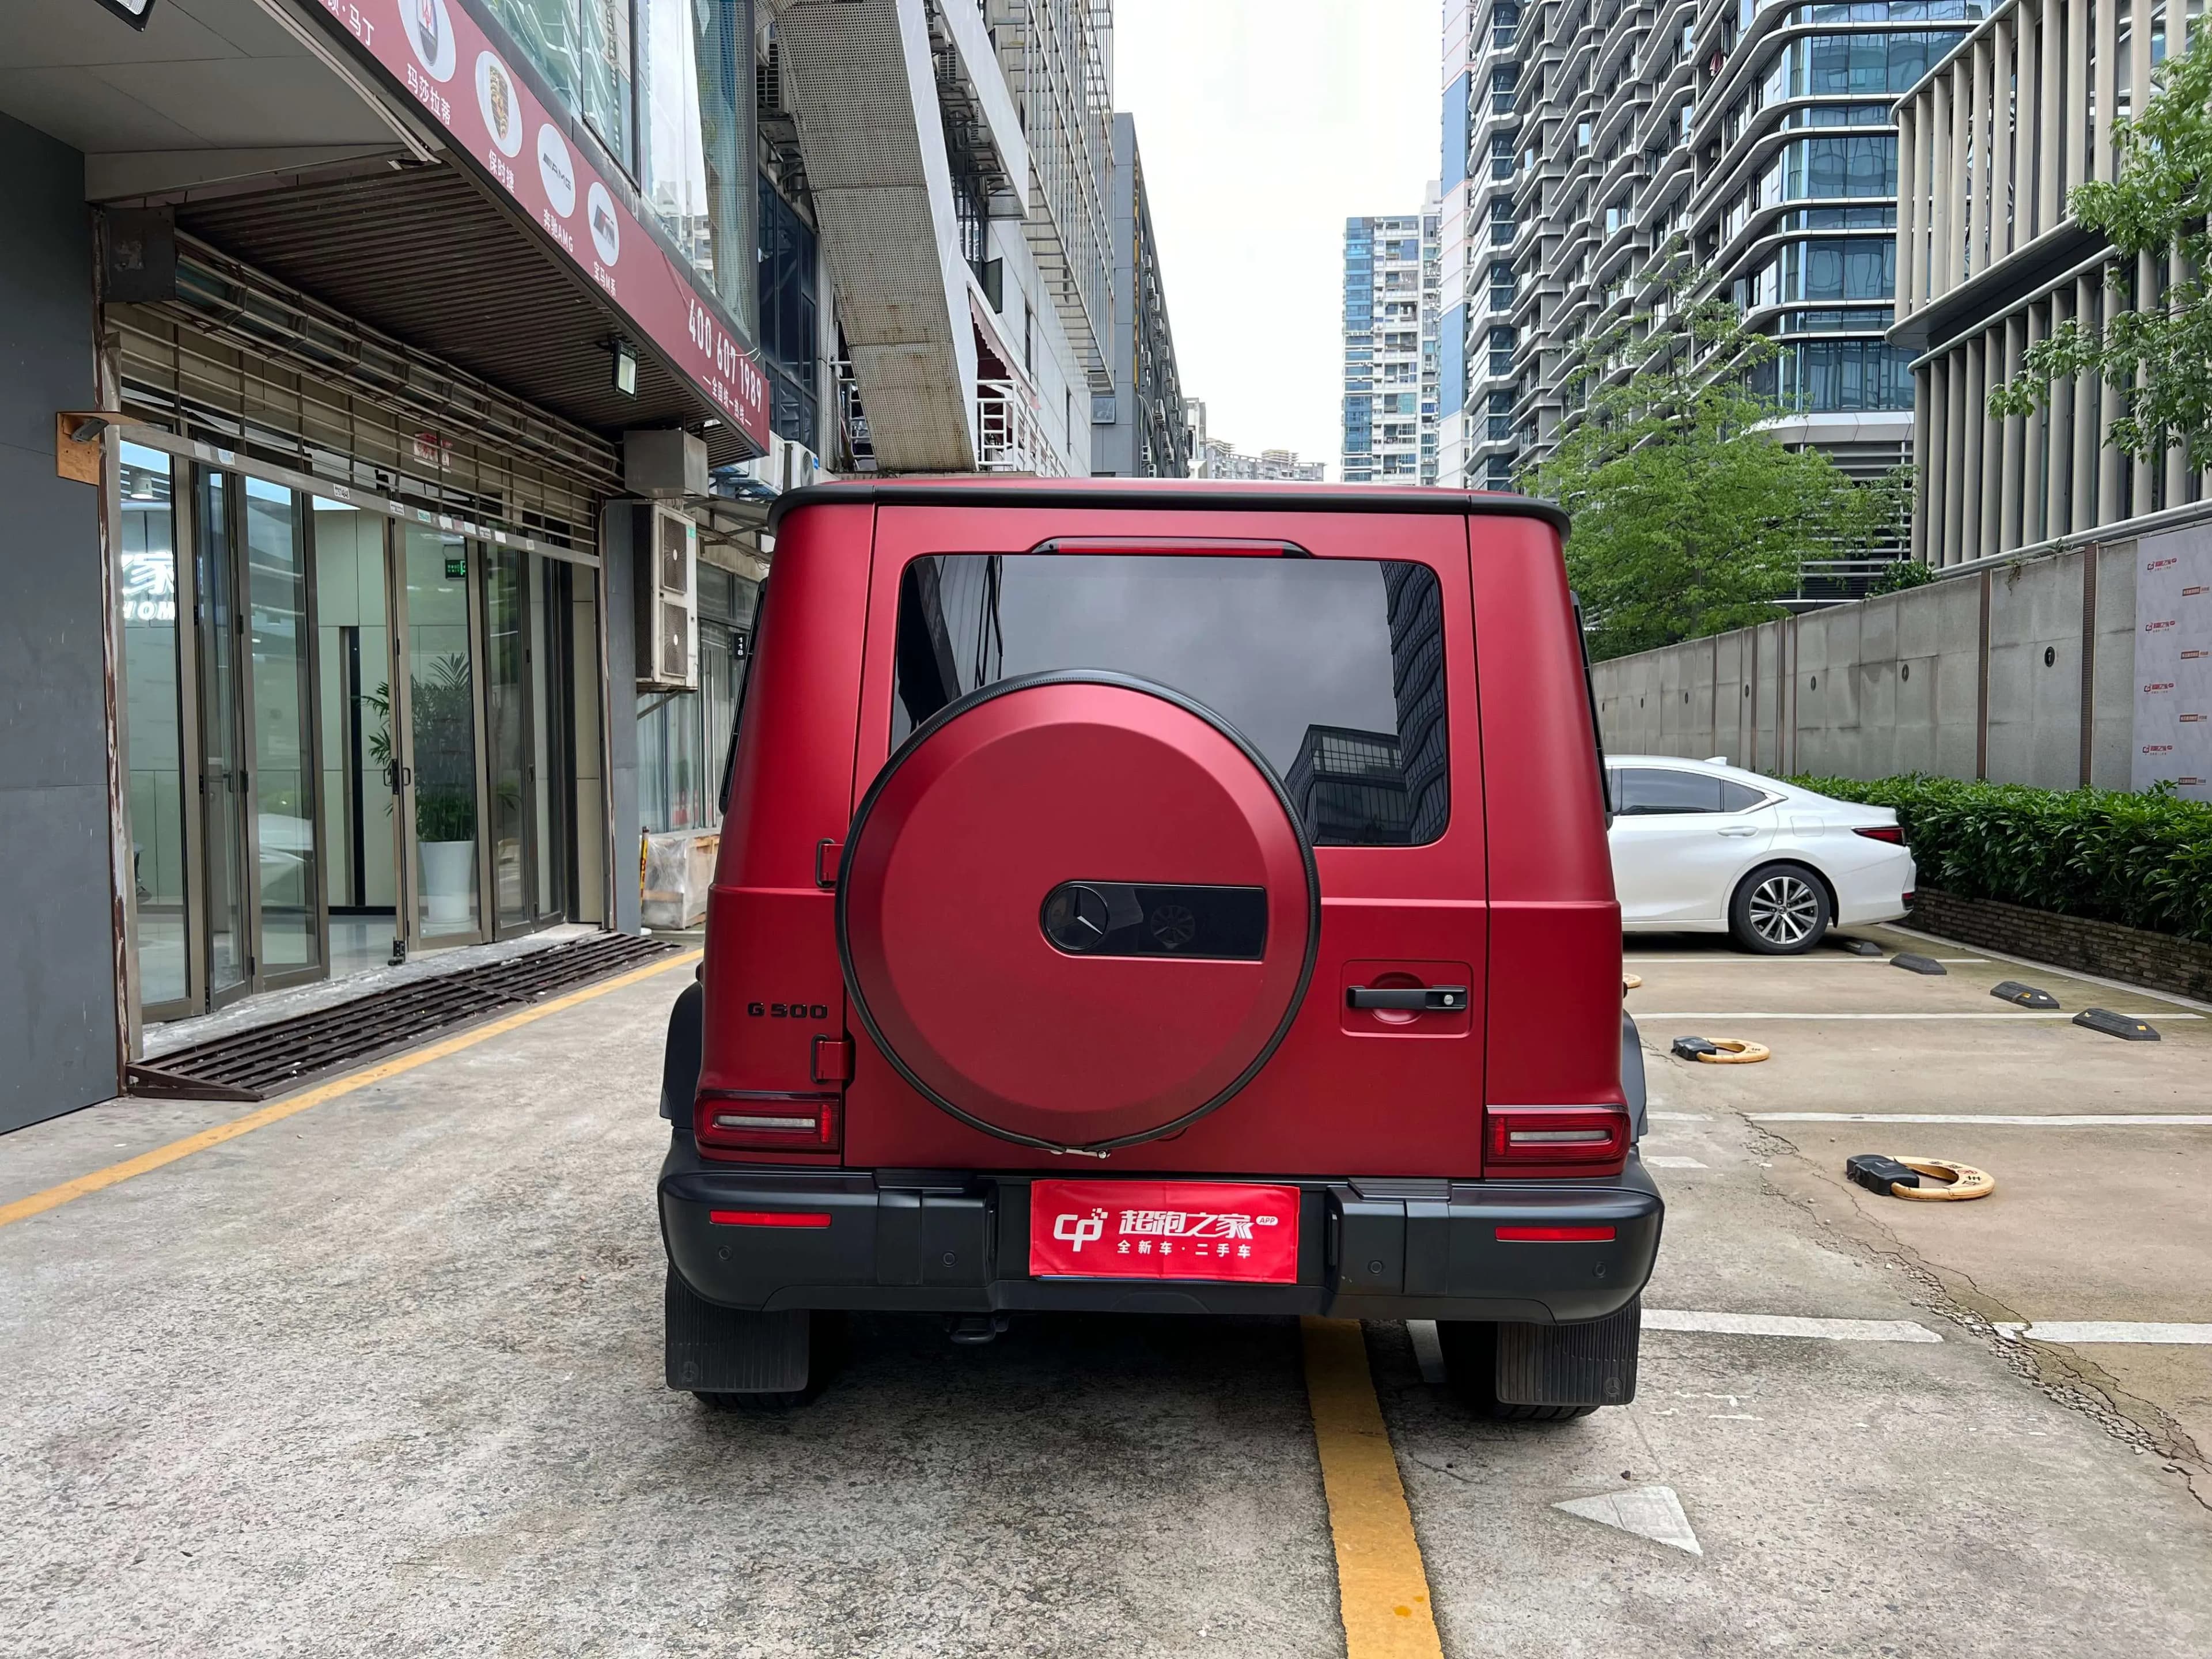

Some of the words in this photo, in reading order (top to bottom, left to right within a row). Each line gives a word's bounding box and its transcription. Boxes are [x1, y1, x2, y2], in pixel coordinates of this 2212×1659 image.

[407, 63, 451, 126] 玛莎拉蒂
[489, 149, 515, 194] 保时捷
[551, 164, 571, 191] AMG
[543, 208, 574, 253] 奔驰AMG
[593, 260, 616, 297] 宝马M系
[689, 298, 712, 359] 400
[717, 331, 736, 385] 607
[740, 357, 762, 413] 1989
[748, 1002, 764, 1017] G
[771, 1003, 828, 1019] 500
[1119, 1210, 1255, 1239] 超跑之家
